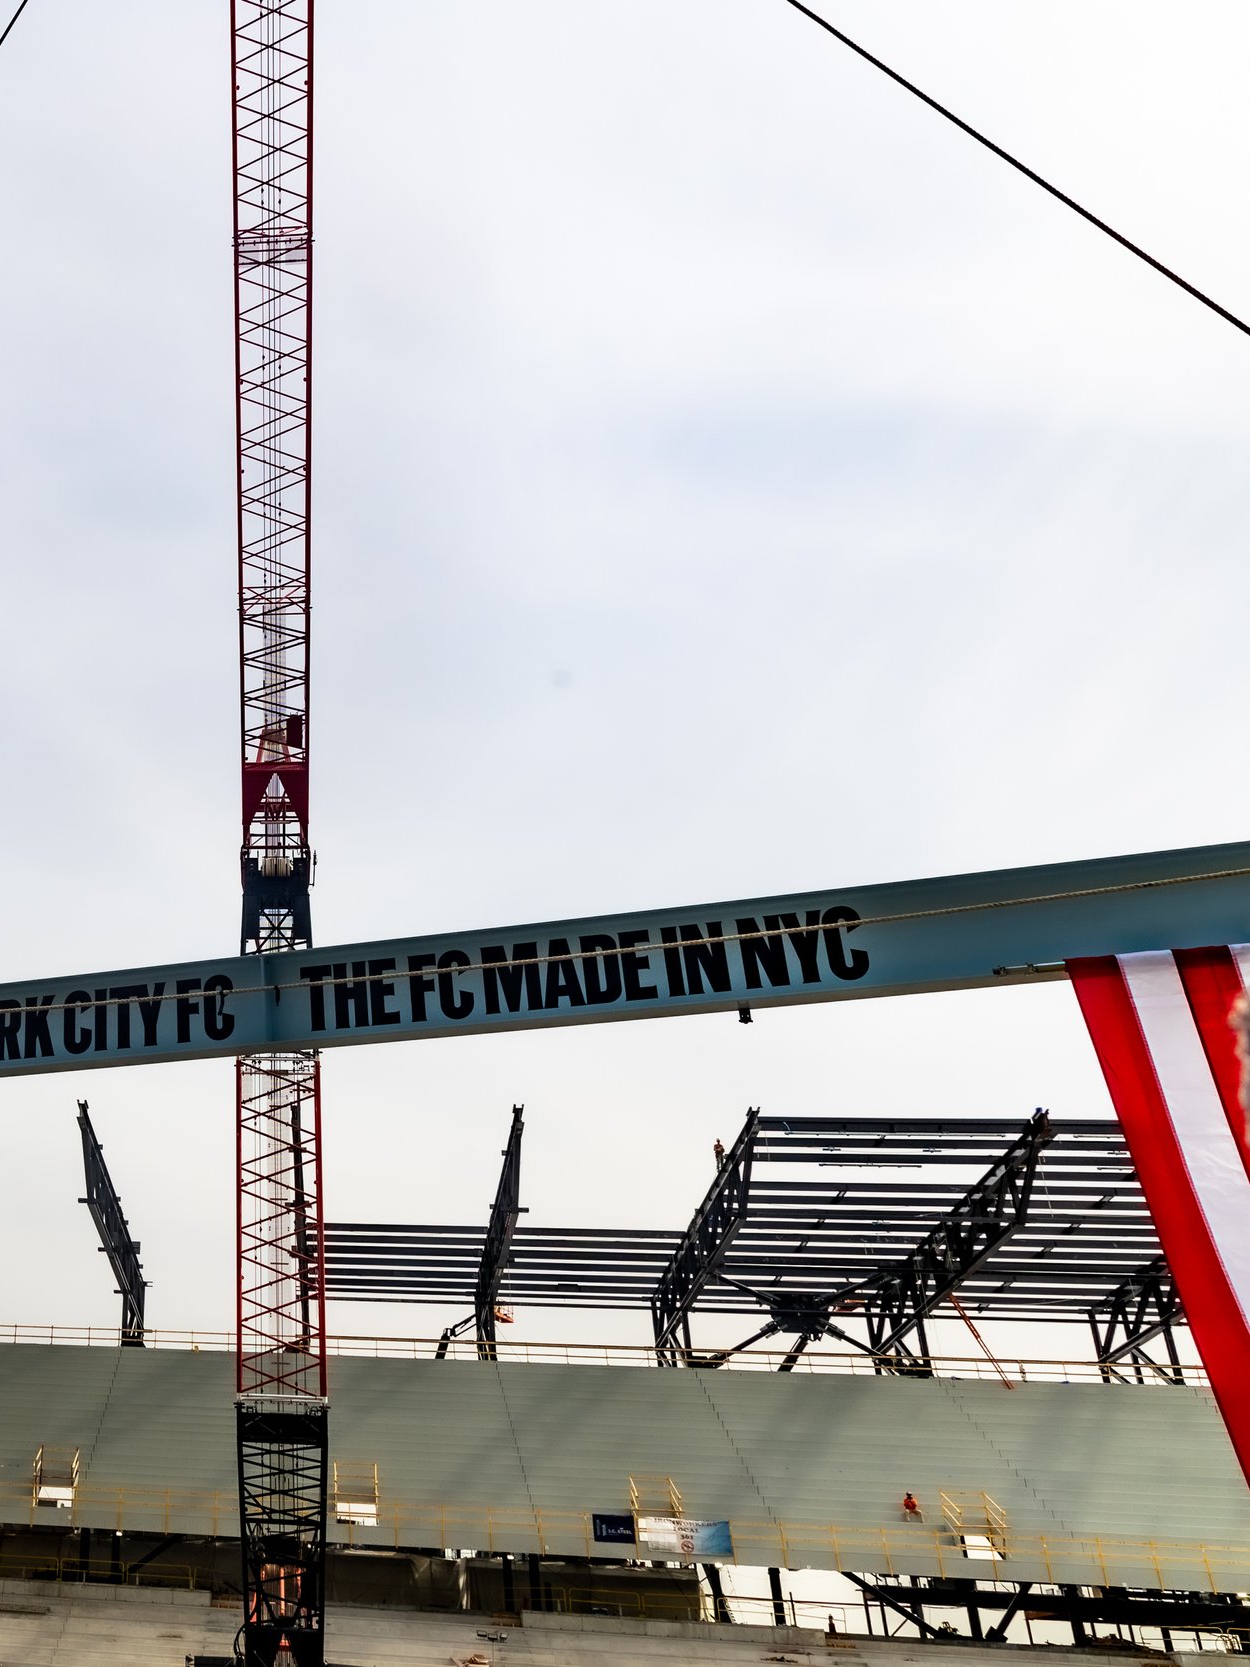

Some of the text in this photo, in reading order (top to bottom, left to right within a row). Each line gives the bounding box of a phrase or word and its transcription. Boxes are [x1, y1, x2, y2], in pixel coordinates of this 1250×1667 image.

[300, 905, 870, 1032] THE FC MADE IN NYC
[63, 982, 167, 1055] CITY
[176, 974, 235, 1043] FC
[673, 1526, 700, 1534] LOCAL
